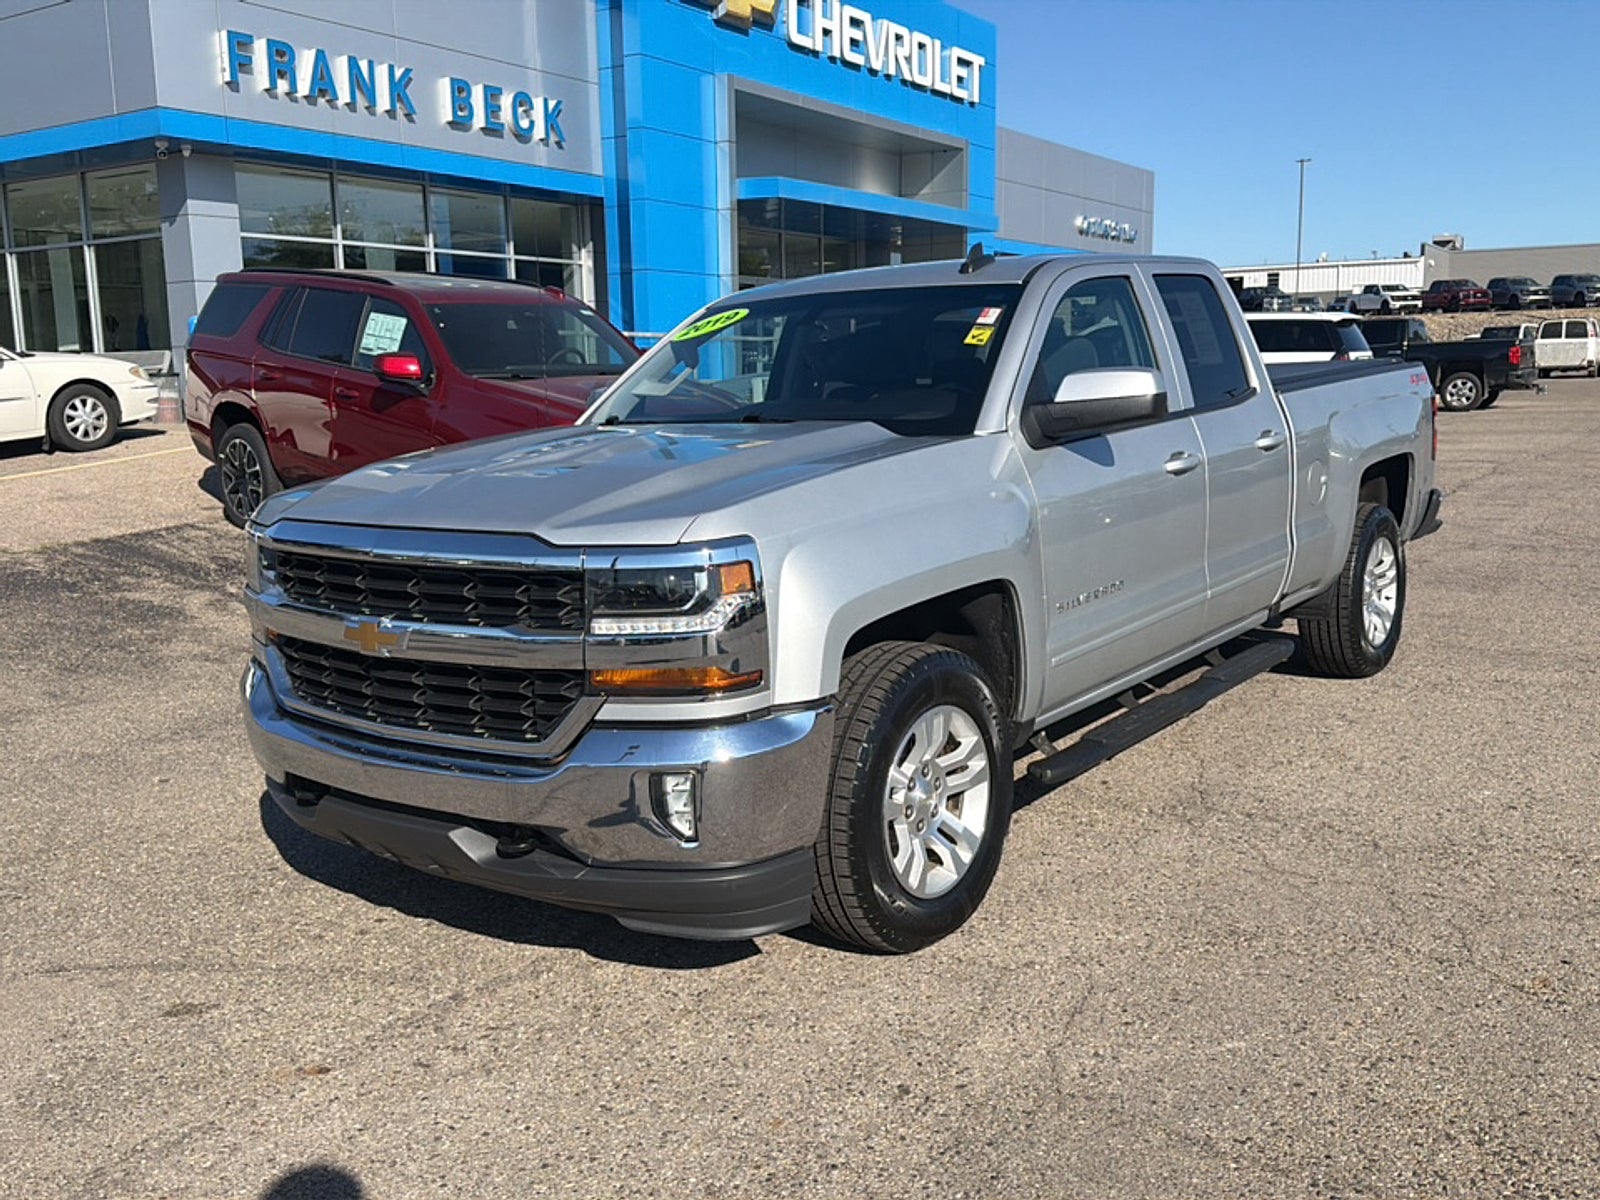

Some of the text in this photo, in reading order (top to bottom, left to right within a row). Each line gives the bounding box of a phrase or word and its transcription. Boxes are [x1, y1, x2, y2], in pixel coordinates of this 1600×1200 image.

[221, 29, 567, 145] FRANK BECK
[785, 0, 985, 104] CHEVROLET
[678, 311, 741, 338] 2019
